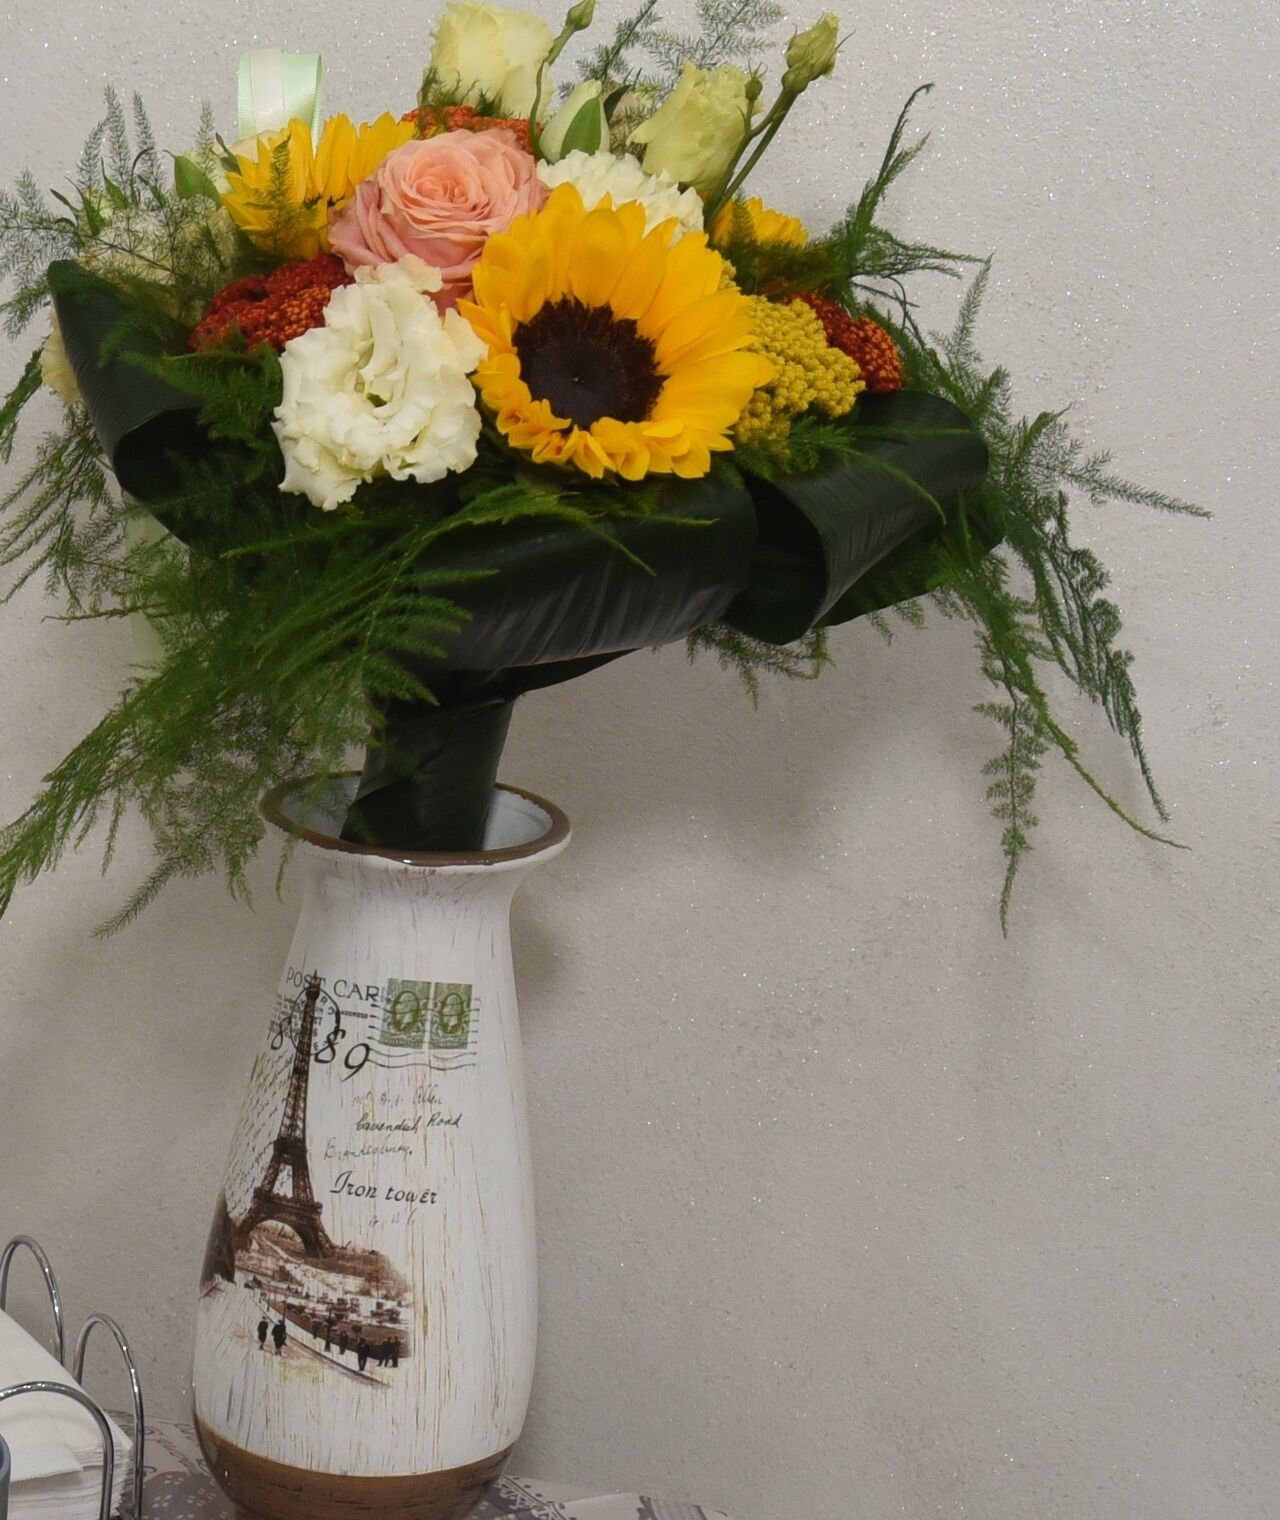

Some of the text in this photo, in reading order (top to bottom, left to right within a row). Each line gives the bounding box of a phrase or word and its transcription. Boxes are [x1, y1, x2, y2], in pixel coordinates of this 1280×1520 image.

[333, 979, 384, 1003] CAR
[330, 1170, 438, 1206] Iron tower
